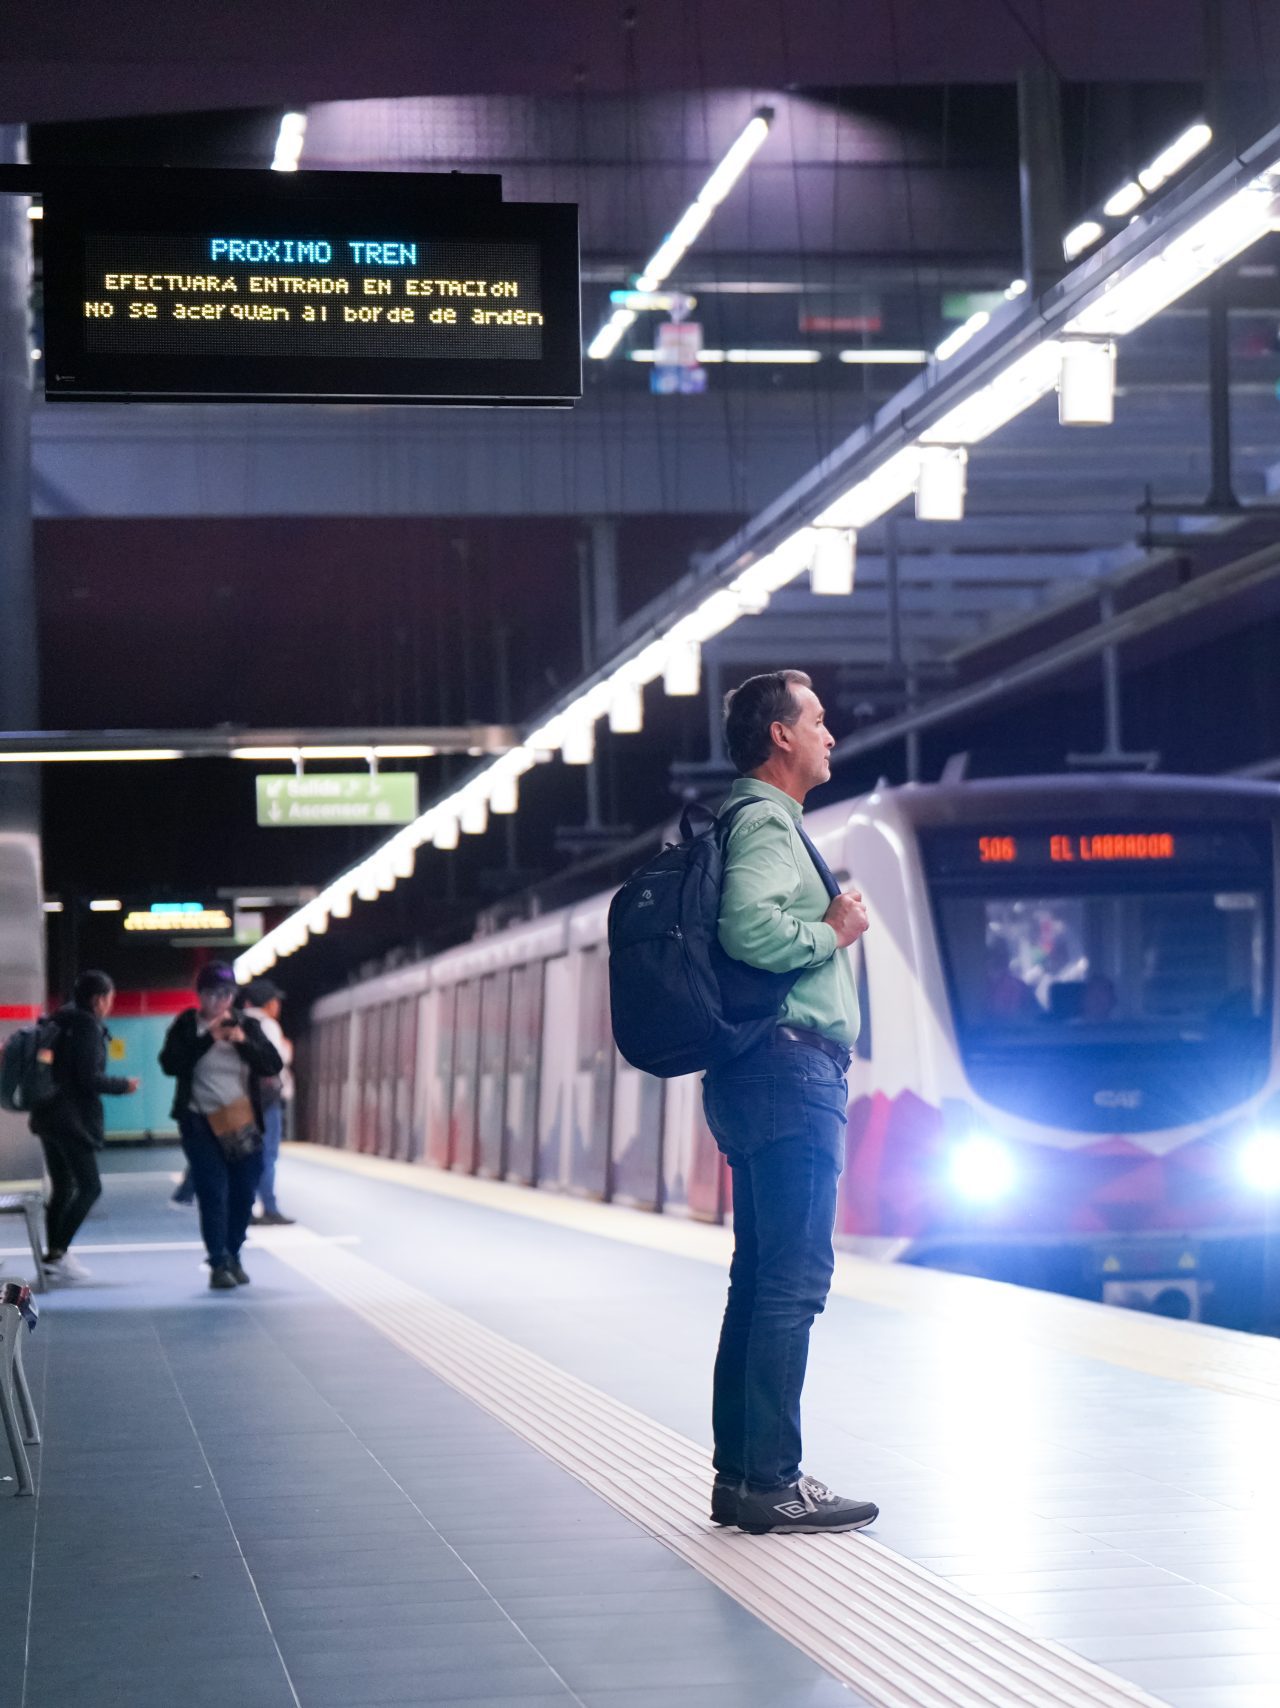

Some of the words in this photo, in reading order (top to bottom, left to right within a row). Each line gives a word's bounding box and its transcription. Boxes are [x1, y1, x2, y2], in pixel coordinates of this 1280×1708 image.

[211, 239, 332, 263] PROXIMO
[349, 242, 417, 265] TREN
[249, 277, 349, 294] ENTRADA
[363, 279, 392, 295] EN
[172, 303, 290, 321] acerquen
[302, 305, 327, 322] al
[344, 305, 415, 323] borde
[429, 308, 457, 324] de
[471, 308, 544, 326] anden
[1050, 835, 1073, 860] EL
